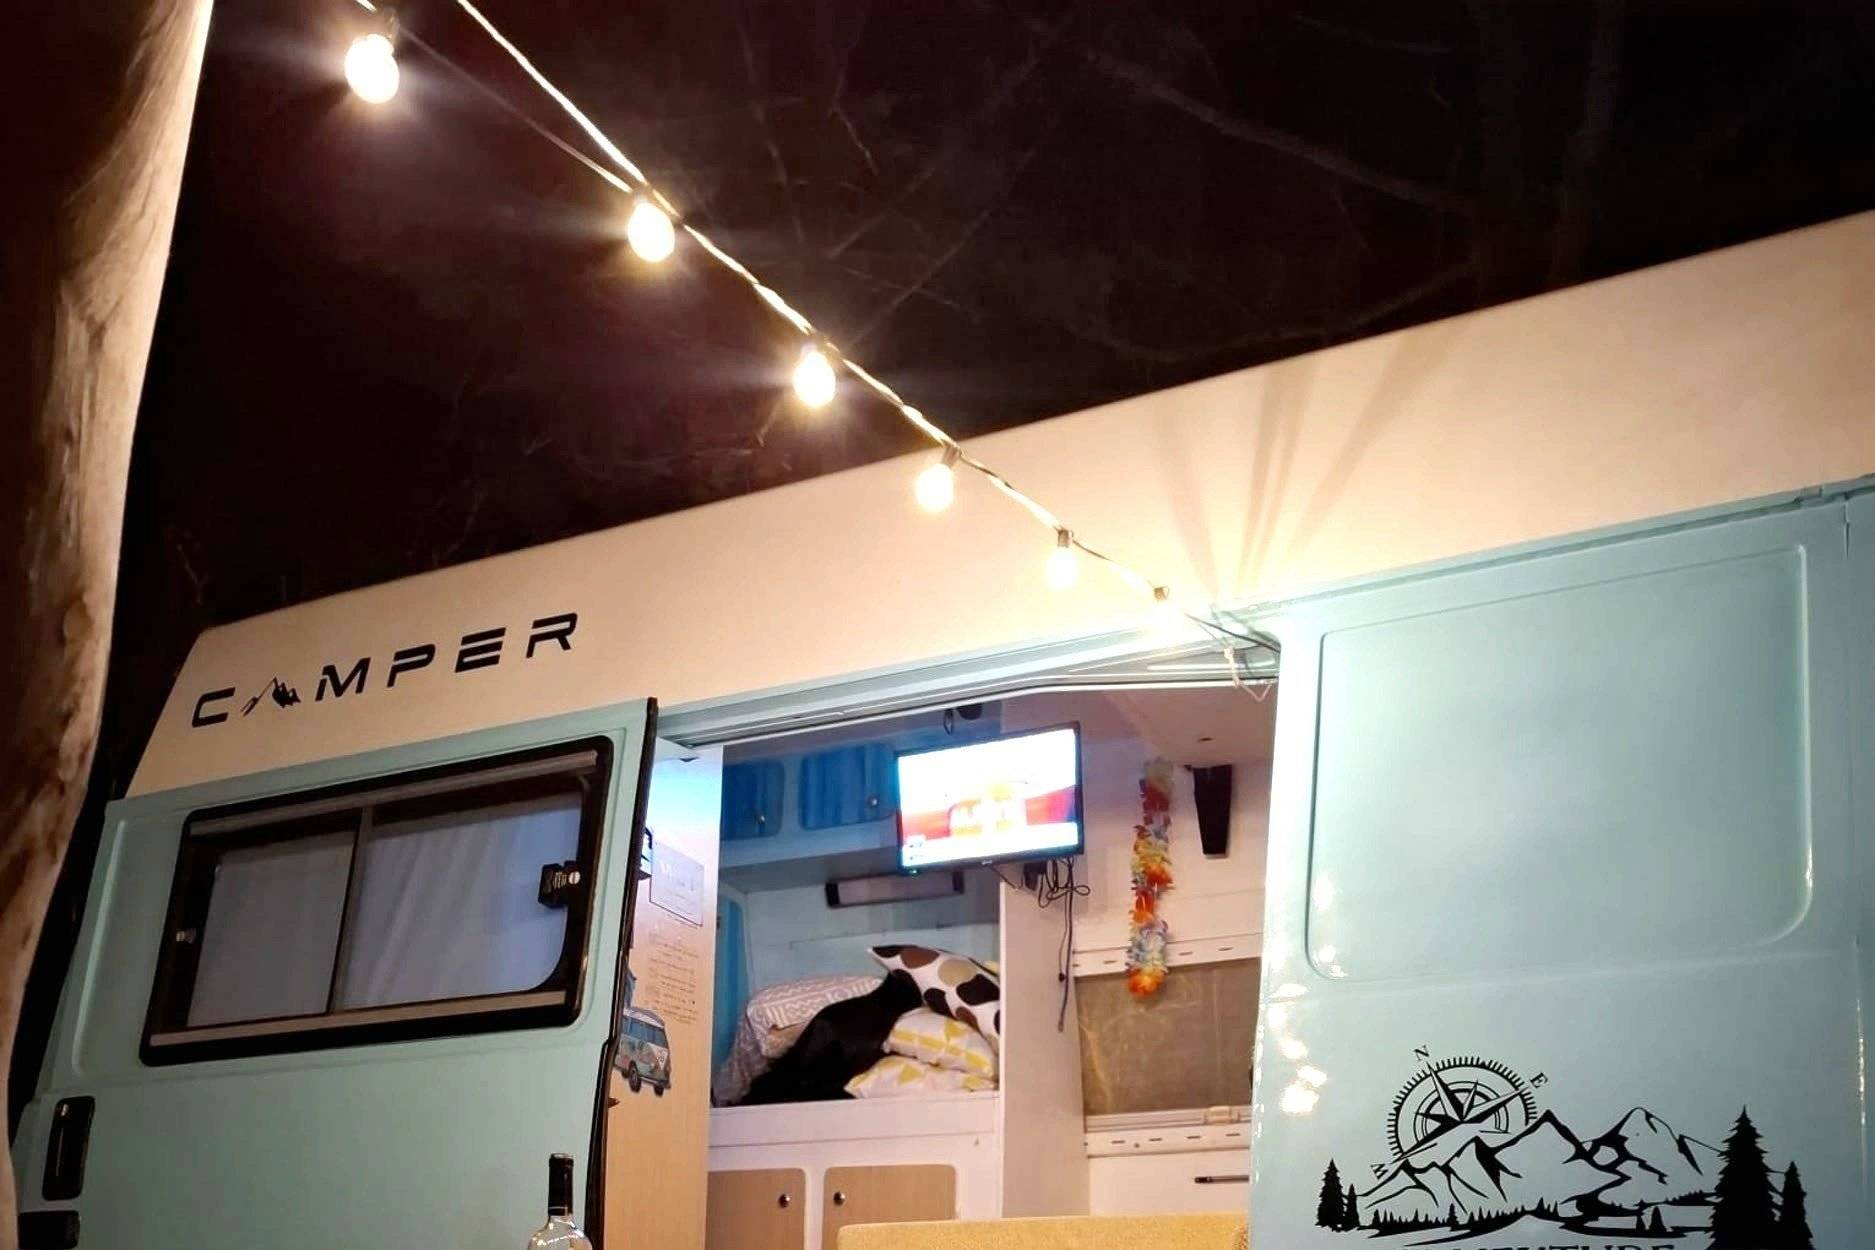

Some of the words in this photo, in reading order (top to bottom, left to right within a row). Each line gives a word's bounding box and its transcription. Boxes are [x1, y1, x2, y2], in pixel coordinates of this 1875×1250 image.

[1413, 1044, 1430, 1061] N
[1529, 1072, 1549, 1089] E
[1370, 1163, 1388, 1180] W
